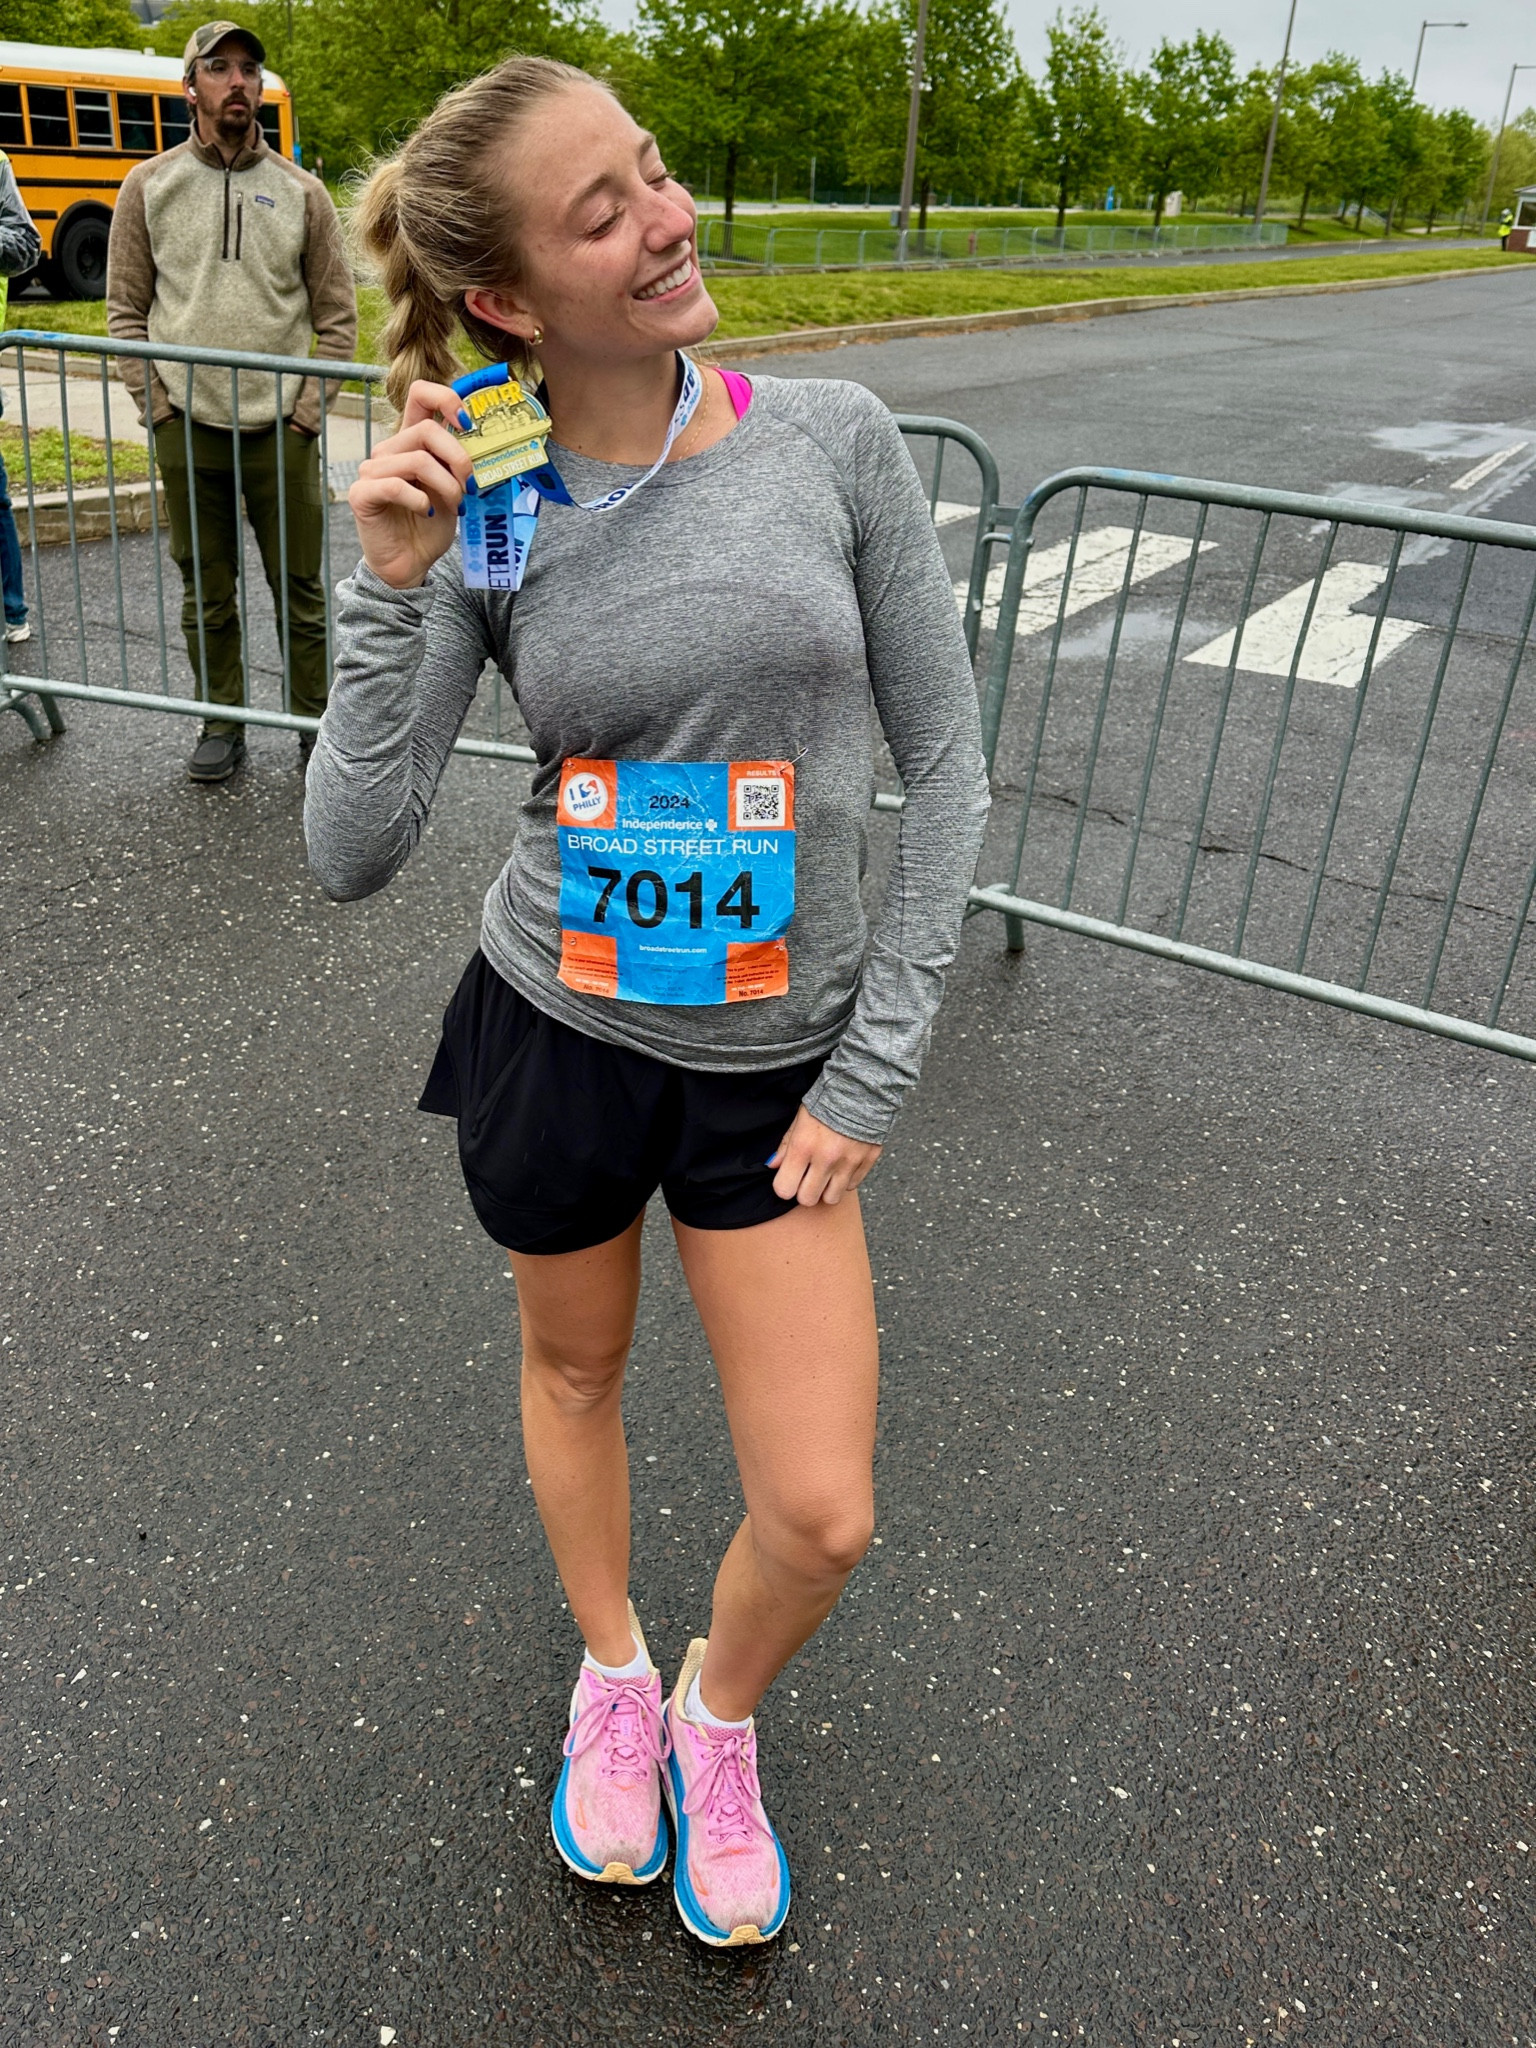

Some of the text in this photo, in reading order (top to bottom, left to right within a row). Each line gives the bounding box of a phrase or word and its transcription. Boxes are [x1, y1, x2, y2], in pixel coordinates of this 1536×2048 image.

[474, 444, 529, 471] Independence
[477, 467, 503, 484] BROAD
[503, 457, 529, 473] STREET
[528, 452, 544, 466] RUN
[746, 769, 777, 777] RESULTS
[568, 788, 576, 801] I
[572, 797, 602, 812] PHILLY
[649, 795, 691, 809] 2024
[622, 818, 703, 831] Independence
[567, 834, 779, 856] BROAD STREET RUN
[587, 865, 760, 929] 7014
[639, 943, 707, 954] broadstreetrun.com
